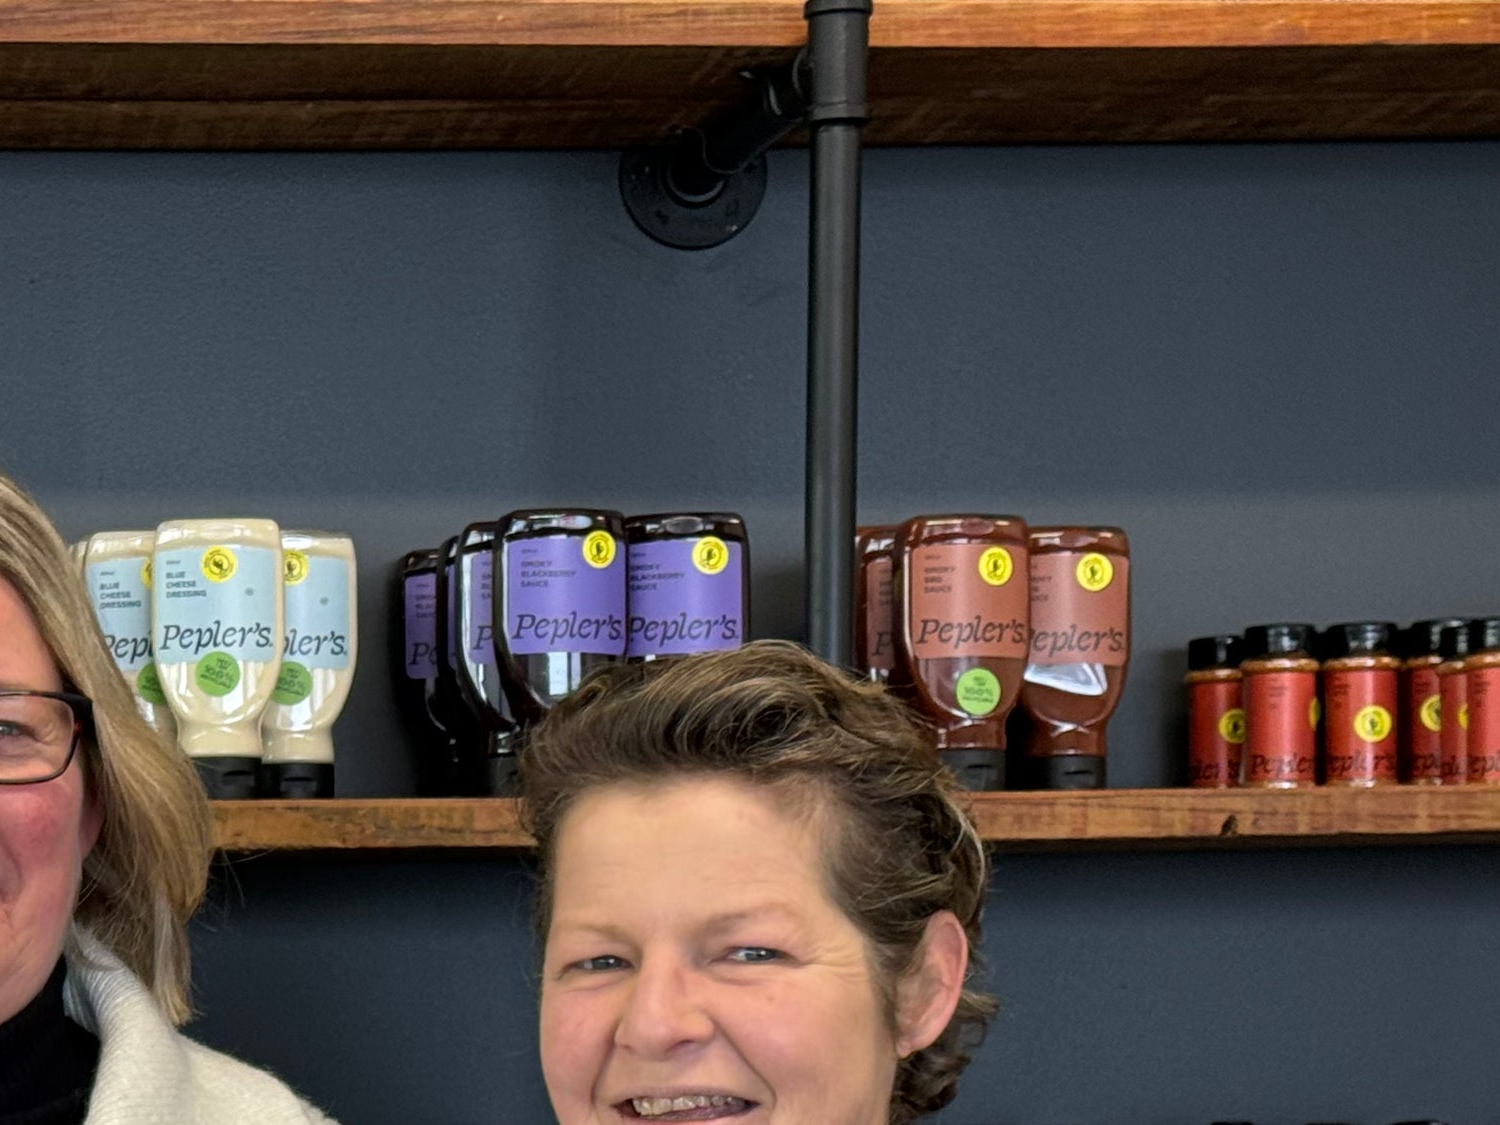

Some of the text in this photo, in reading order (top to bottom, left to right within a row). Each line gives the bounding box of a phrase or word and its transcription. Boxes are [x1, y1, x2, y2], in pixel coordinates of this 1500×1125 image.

[166, 571, 185, 579] BLUE
[166, 580, 196, 588] CHEESE
[100, 591, 131, 599] CHEESE
[166, 590, 207, 598] DRESSING
[100, 600, 142, 608] DRESSING
